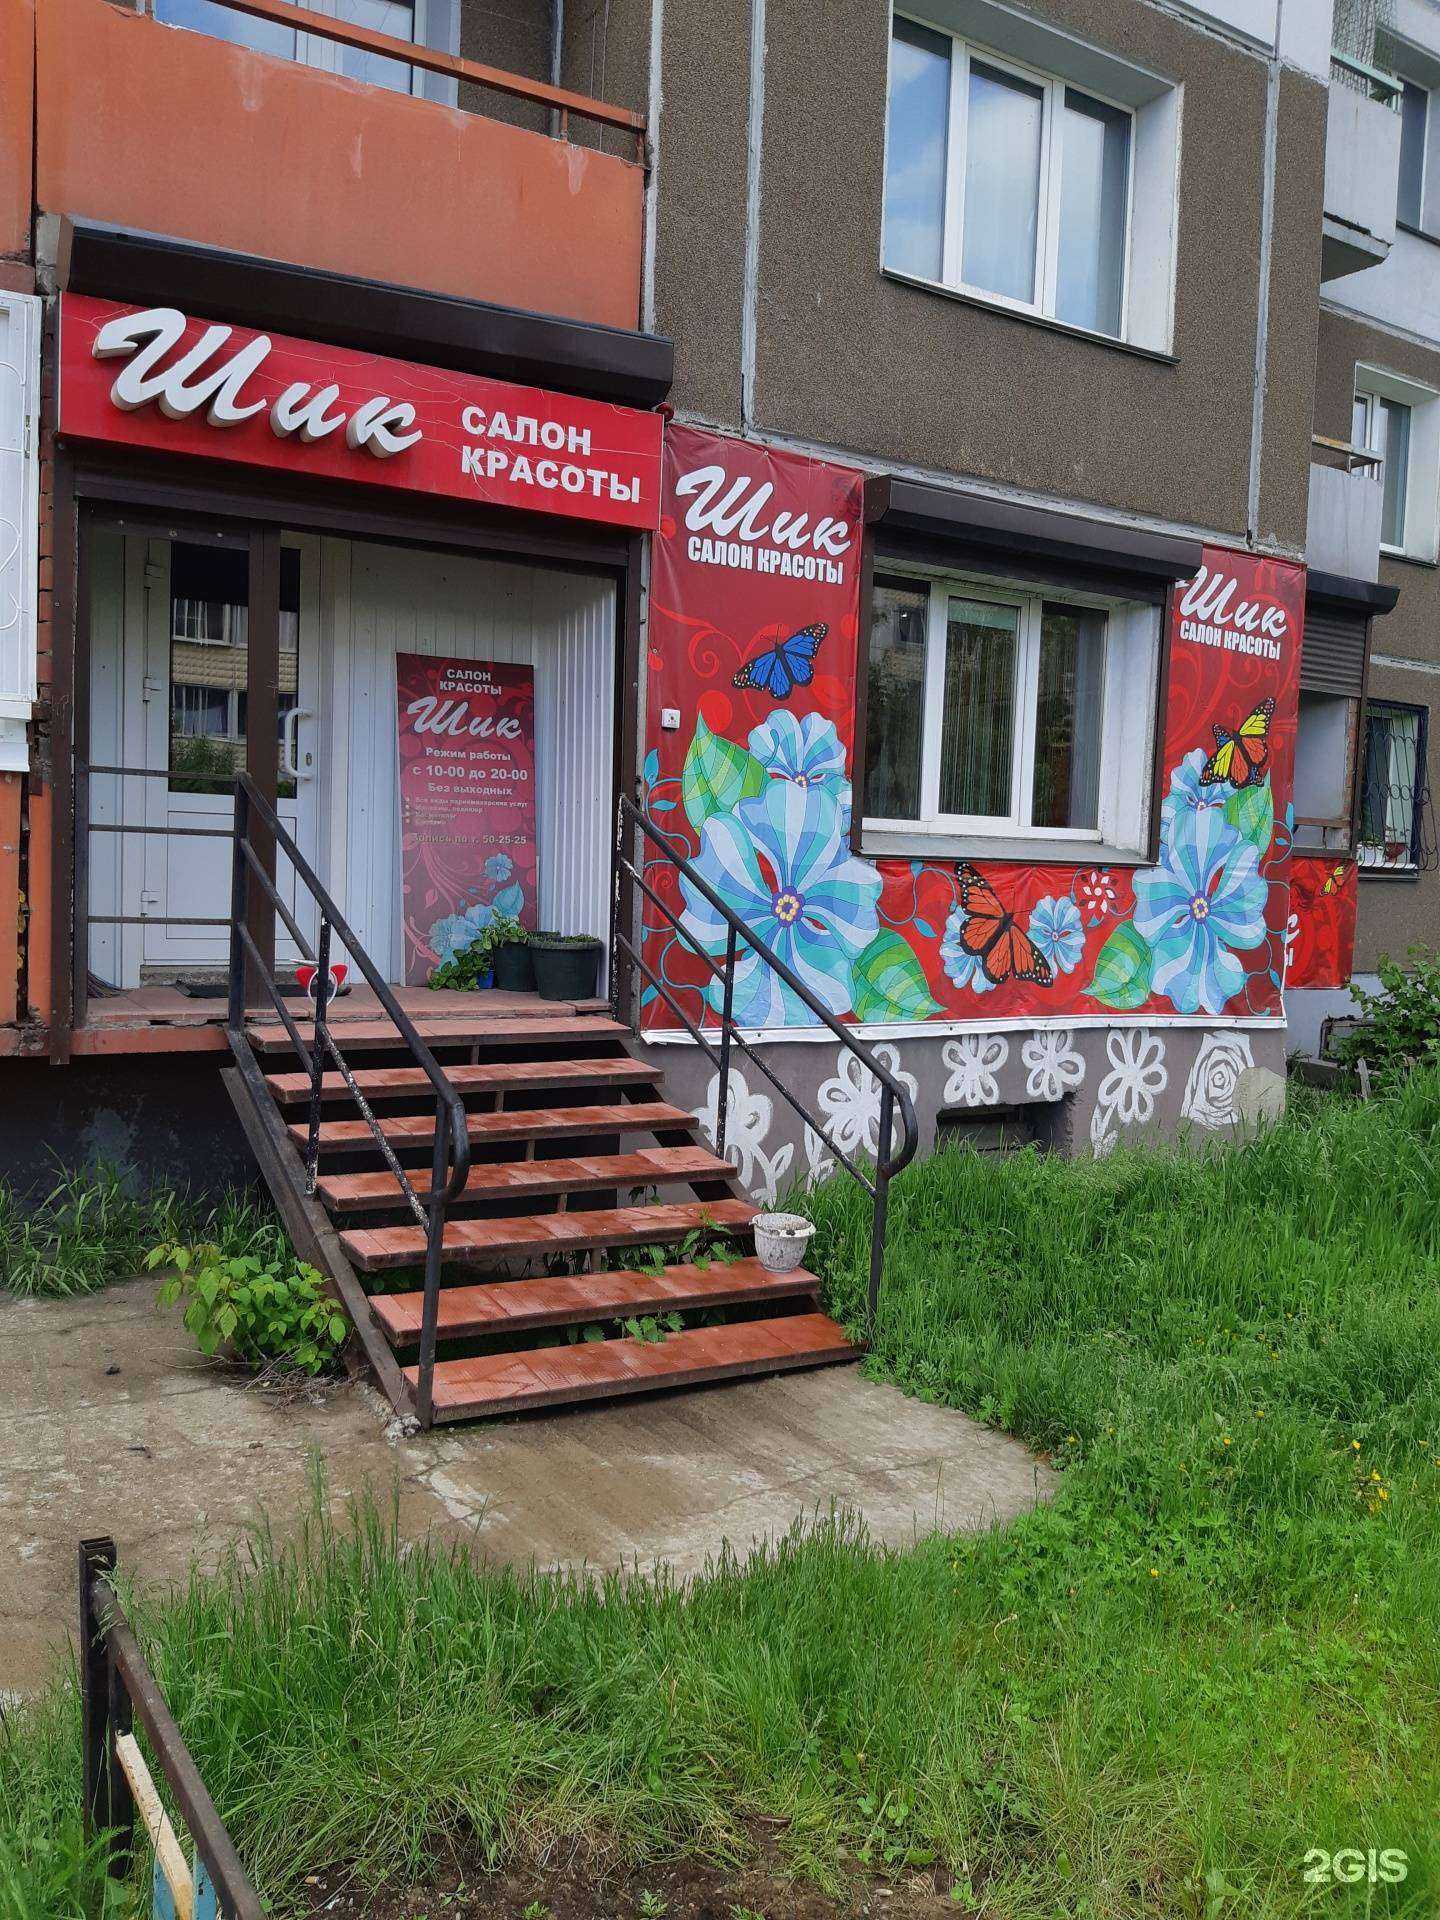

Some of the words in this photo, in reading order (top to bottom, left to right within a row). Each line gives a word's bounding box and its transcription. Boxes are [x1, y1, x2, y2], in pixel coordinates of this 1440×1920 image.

[92, 307, 423, 459] Шик
[461, 405, 591, 457] САЛОН
[461, 446, 640, 504] КРАСОТЫ
[675, 465, 852, 556] Шик
[687, 536, 753, 571] САЛОН
[757, 548, 843, 585] КРАСОТЫ
[1175, 565, 1287, 638] Шик
[1180, 620, 1222, 648] САЛОН
[1224, 630, 1281, 660] КРАСОТЫ
[440, 680, 502, 696] КРАСОТЫ
[446, 668, 492, 682] САЛОН
[406, 695, 522, 740] Шик
[412, 766, 422, 776] с
[426, 765, 465, 778] 10-00
[469, 769, 486, 780] до
[490, 768, 528, 781] 20-00
[425, 747, 466, 759] Режим
[469, 749, 512, 762] работы
[427, 782, 450, 793] Без
[453, 785, 513, 797] выходных
[482, 834, 527, 845] 50-25-25
